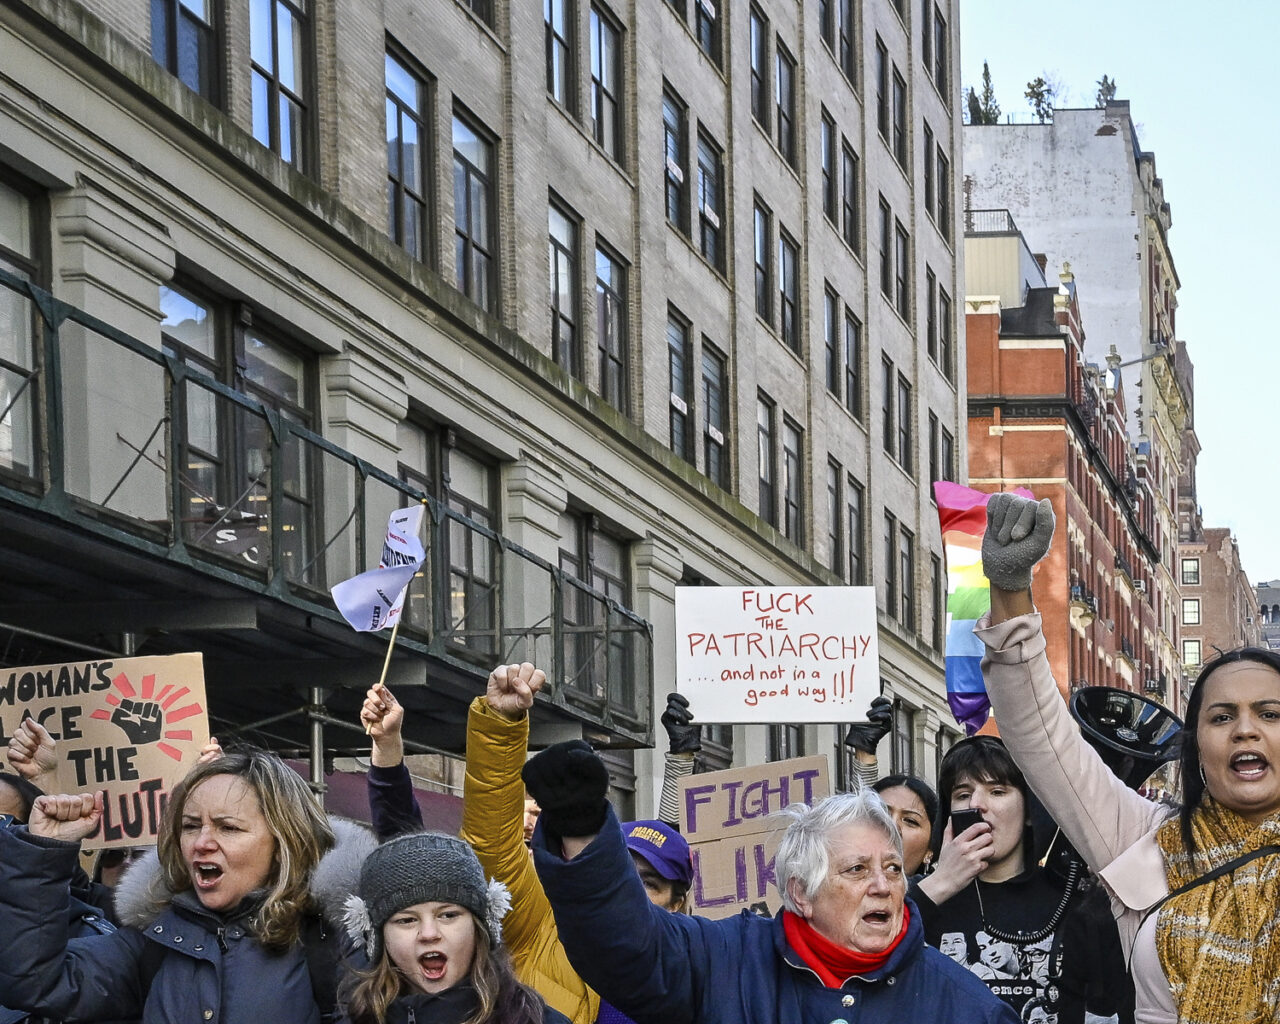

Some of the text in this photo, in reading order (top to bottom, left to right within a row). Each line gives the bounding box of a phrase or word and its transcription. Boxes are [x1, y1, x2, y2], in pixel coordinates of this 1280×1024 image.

[742, 590, 814, 615] FUCK
[755, 616, 788, 631] THE
[688, 633, 870, 661] PATRIARCHY
[760, 664, 785, 680] not
[793, 665, 806, 681] in
[811, 669, 821, 679] a
[744, 684, 789, 706] good
[67, 746, 140, 787] THE
[684, 769, 820, 834] FIGHT
[691, 843, 777, 908] LIK
